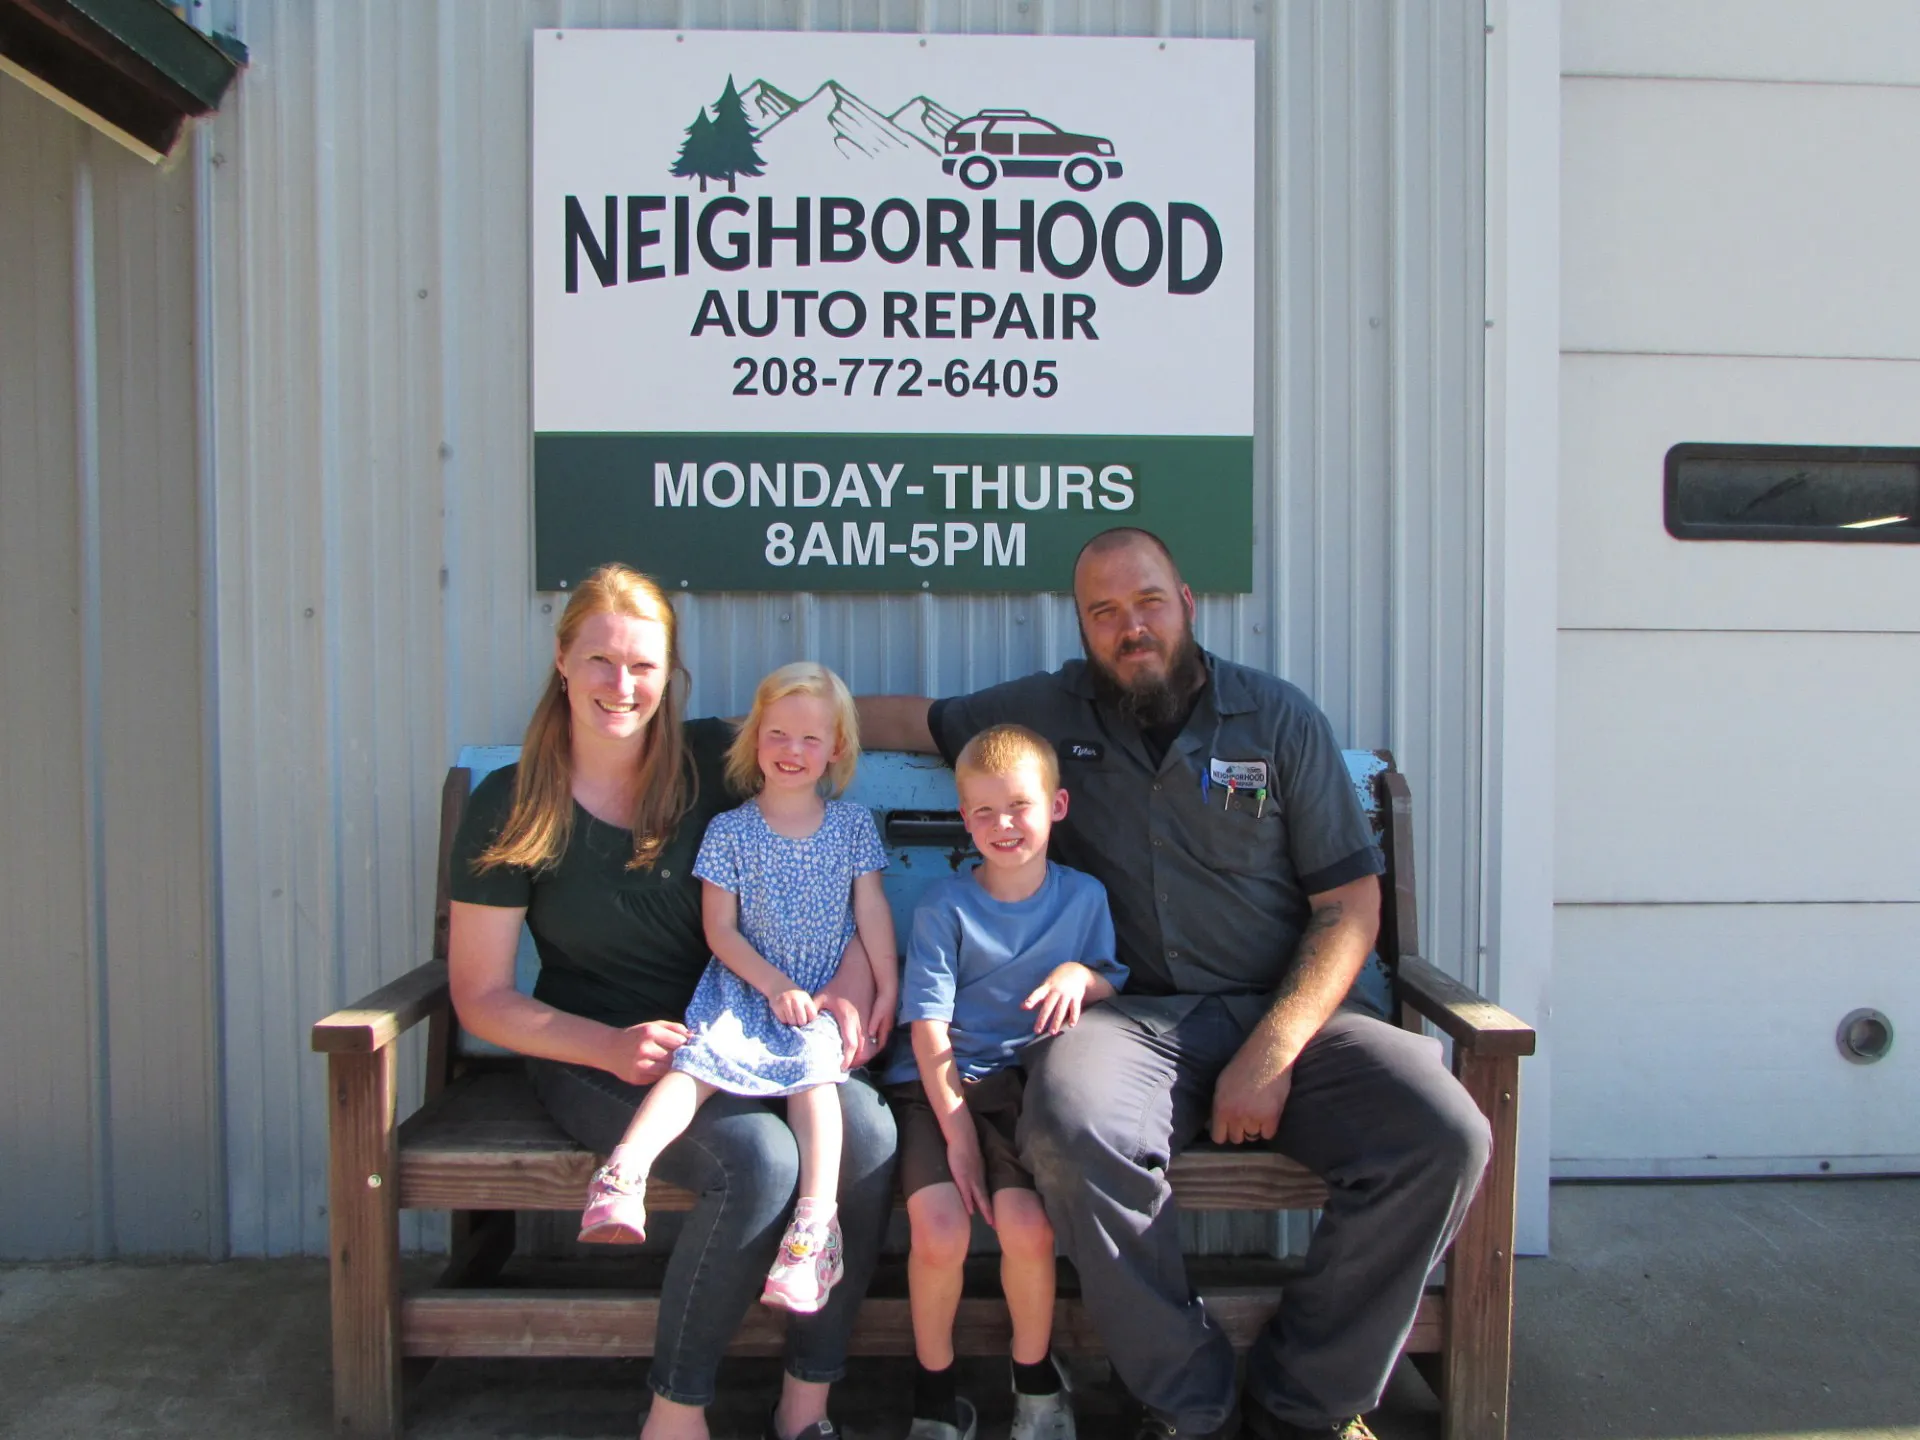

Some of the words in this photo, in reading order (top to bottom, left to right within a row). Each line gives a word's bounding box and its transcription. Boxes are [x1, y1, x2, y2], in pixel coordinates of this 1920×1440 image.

[565, 195, 1222, 295] NEIGHBORHOOD
[690, 290, 866, 338] AUTO
[883, 292, 1099, 340] REPAIR
[732, 357, 1058, 398] 208-772-6405
[653, 462, 924, 508] MONDAY-
[932, 465, 1135, 510] THURS
[764, 523, 1026, 567] 8AM-5PM
